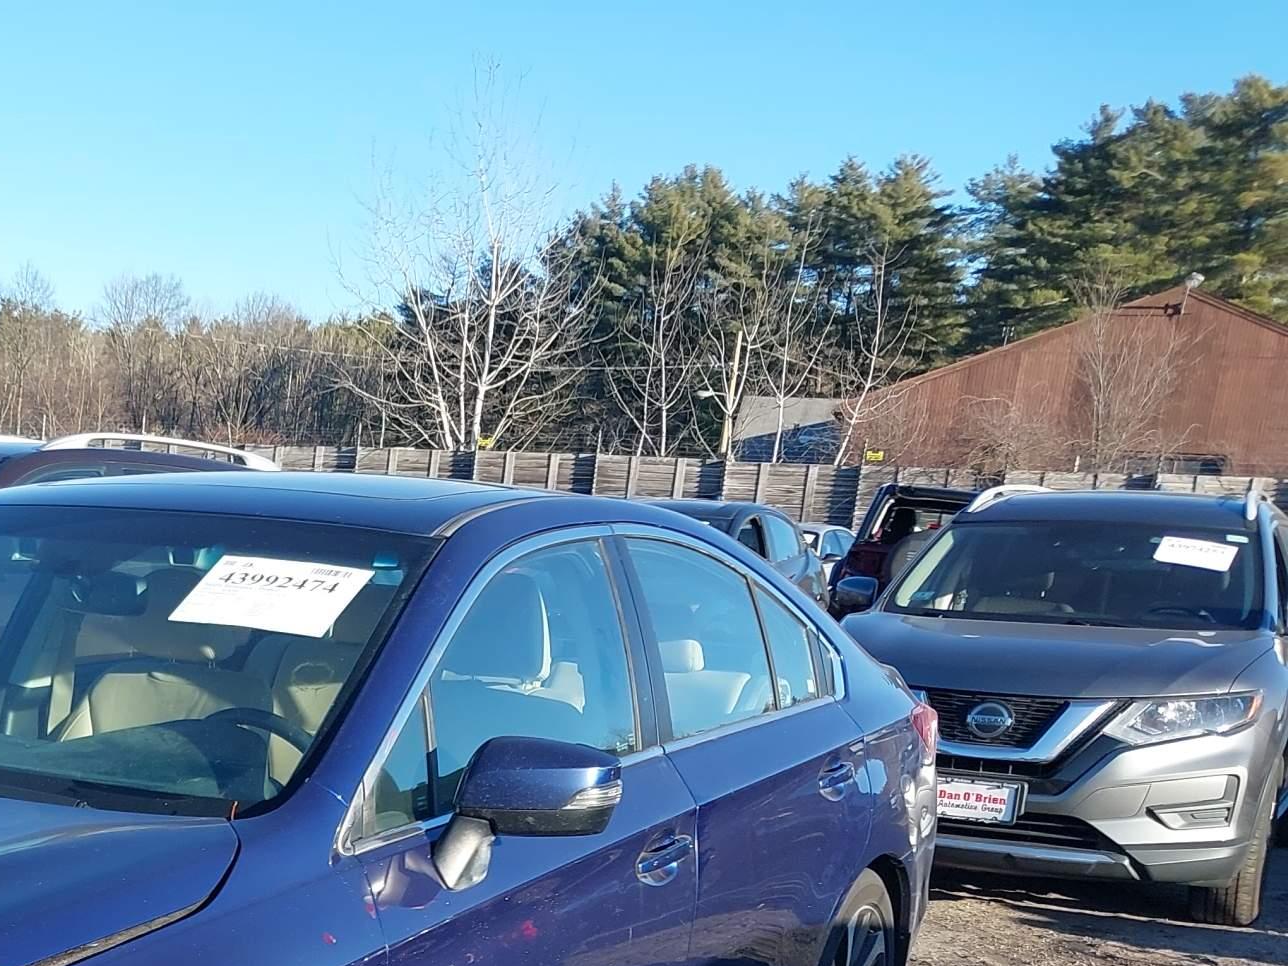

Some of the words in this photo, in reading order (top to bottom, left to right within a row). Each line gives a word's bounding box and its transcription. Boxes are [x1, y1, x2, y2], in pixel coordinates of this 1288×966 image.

[219, 571, 340, 593] 43992474
[938, 790, 961, 800] Dan
[963, 792, 1007, 805] O'Brien
[981, 804, 1004, 814] Group
